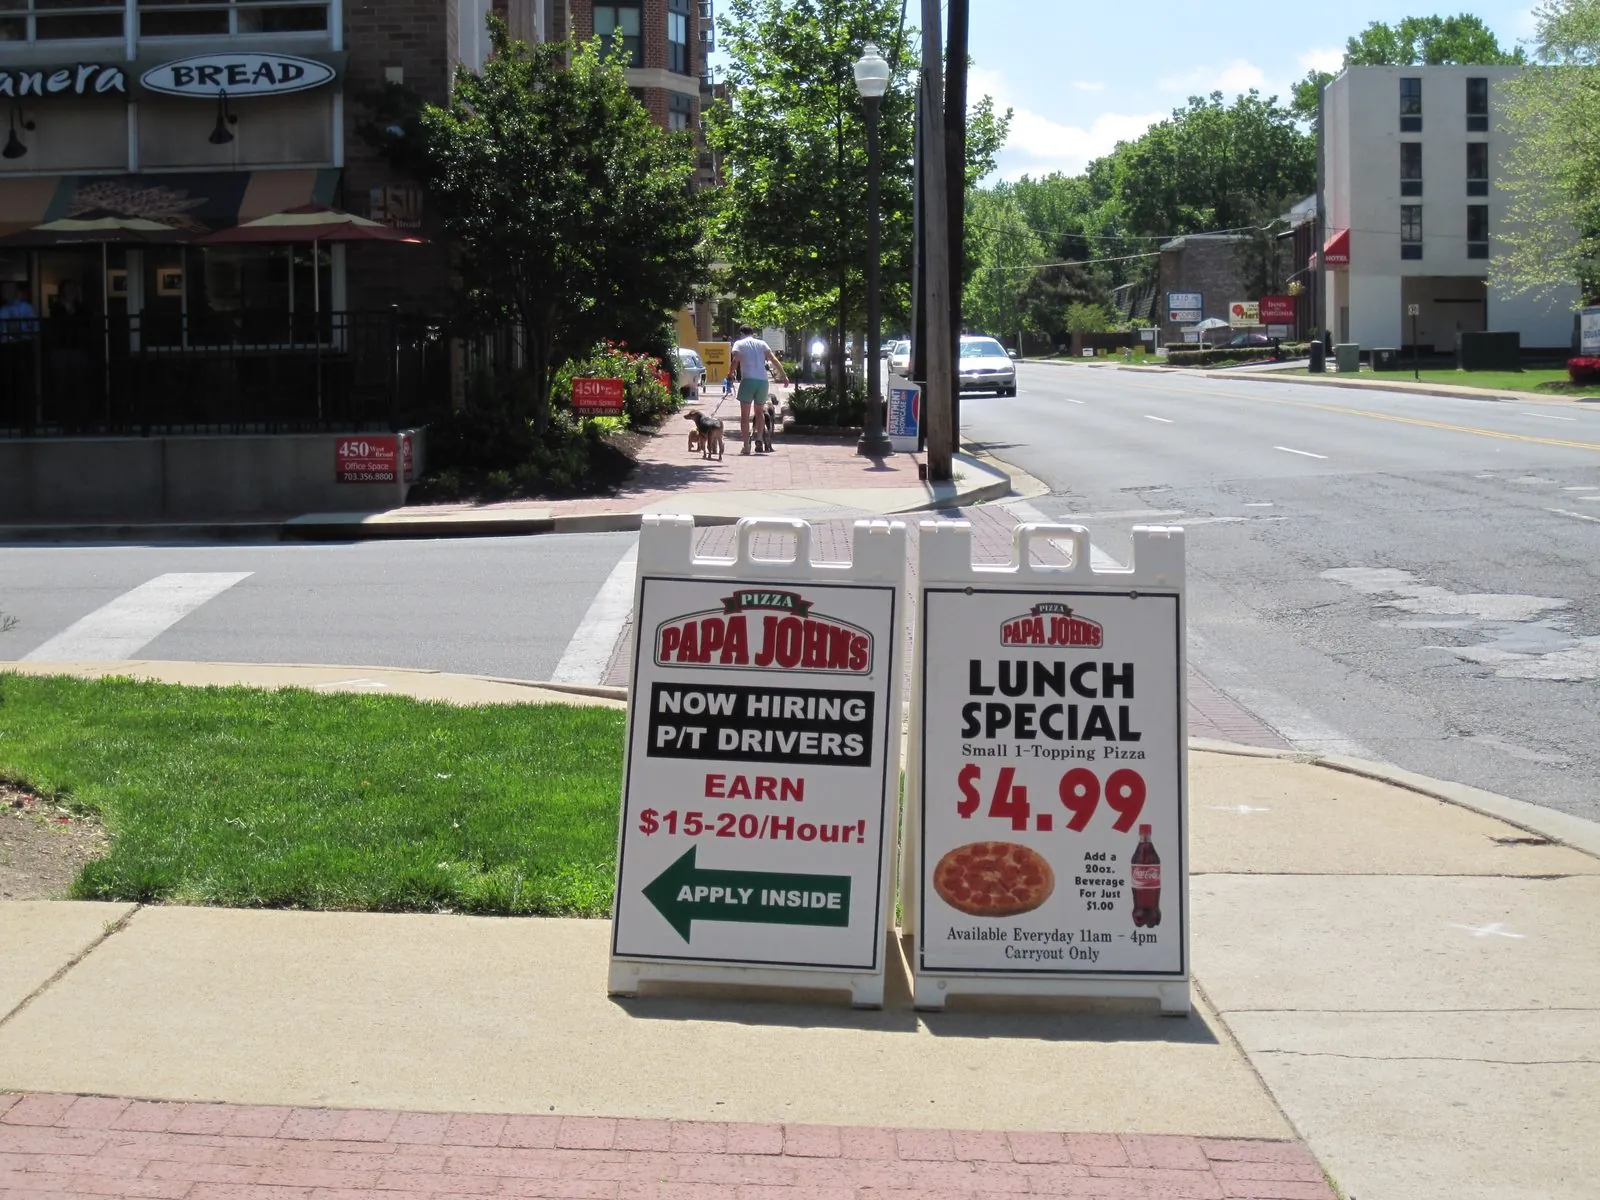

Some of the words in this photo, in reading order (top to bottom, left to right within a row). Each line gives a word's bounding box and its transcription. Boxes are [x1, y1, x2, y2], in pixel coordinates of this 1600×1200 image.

[171, 62, 304, 86] BREAD
[575, 382, 600, 395] 450
[889, 390, 900, 434] APARTMENT
[339, 441, 369, 457] 450
[345, 462, 366, 470] Office
[368, 462, 389, 472] Space
[344, 473, 393, 481] 703.356.8800
[741, 593, 793, 609] PIZZA
[1039, 604, 1064, 613] PIZZA
[1003, 616, 1045, 644] PAPA
[660, 615, 749, 665] PAPA
[755, 615, 868, 671] JOHN'S
[969, 659, 1135, 699] LUNCH
[658, 691, 737, 717] NOW
[747, 694, 866, 722] HIRING
[961, 701, 1142, 742] SPECIAL
[656, 725, 707, 750] P/T
[718, 728, 864, 757] DRIVERS
[961, 743, 1008, 758] Small
[1015, 745, 1096, 762] 1-Topping
[1103, 746, 1146, 760] Pizza
[704, 773, 805, 802] EARN
[957, 763, 1147, 834] $4.99
[638, 807, 866, 844] $15-20/Hour!
[1084, 852, 1106, 861] Add
[1085, 864, 1116, 873] 20oz.
[1075, 876, 1125, 888] Beverage
[677, 885, 753, 905] APPLY
[761, 889, 842, 909] INSIDE
[1080, 888, 1096, 898] For
[1101, 889, 1121, 898] Just
[1087, 901, 1114, 911] $1.00
[947, 926, 1007, 942] Available
[1013, 928, 1074, 944] Everyday
[1080, 928, 1112, 943] 11am
[1129, 930, 1158, 946] 4pm
[1004, 945, 1064, 962] Carryout
[1069, 946, 1100, 963] Only
